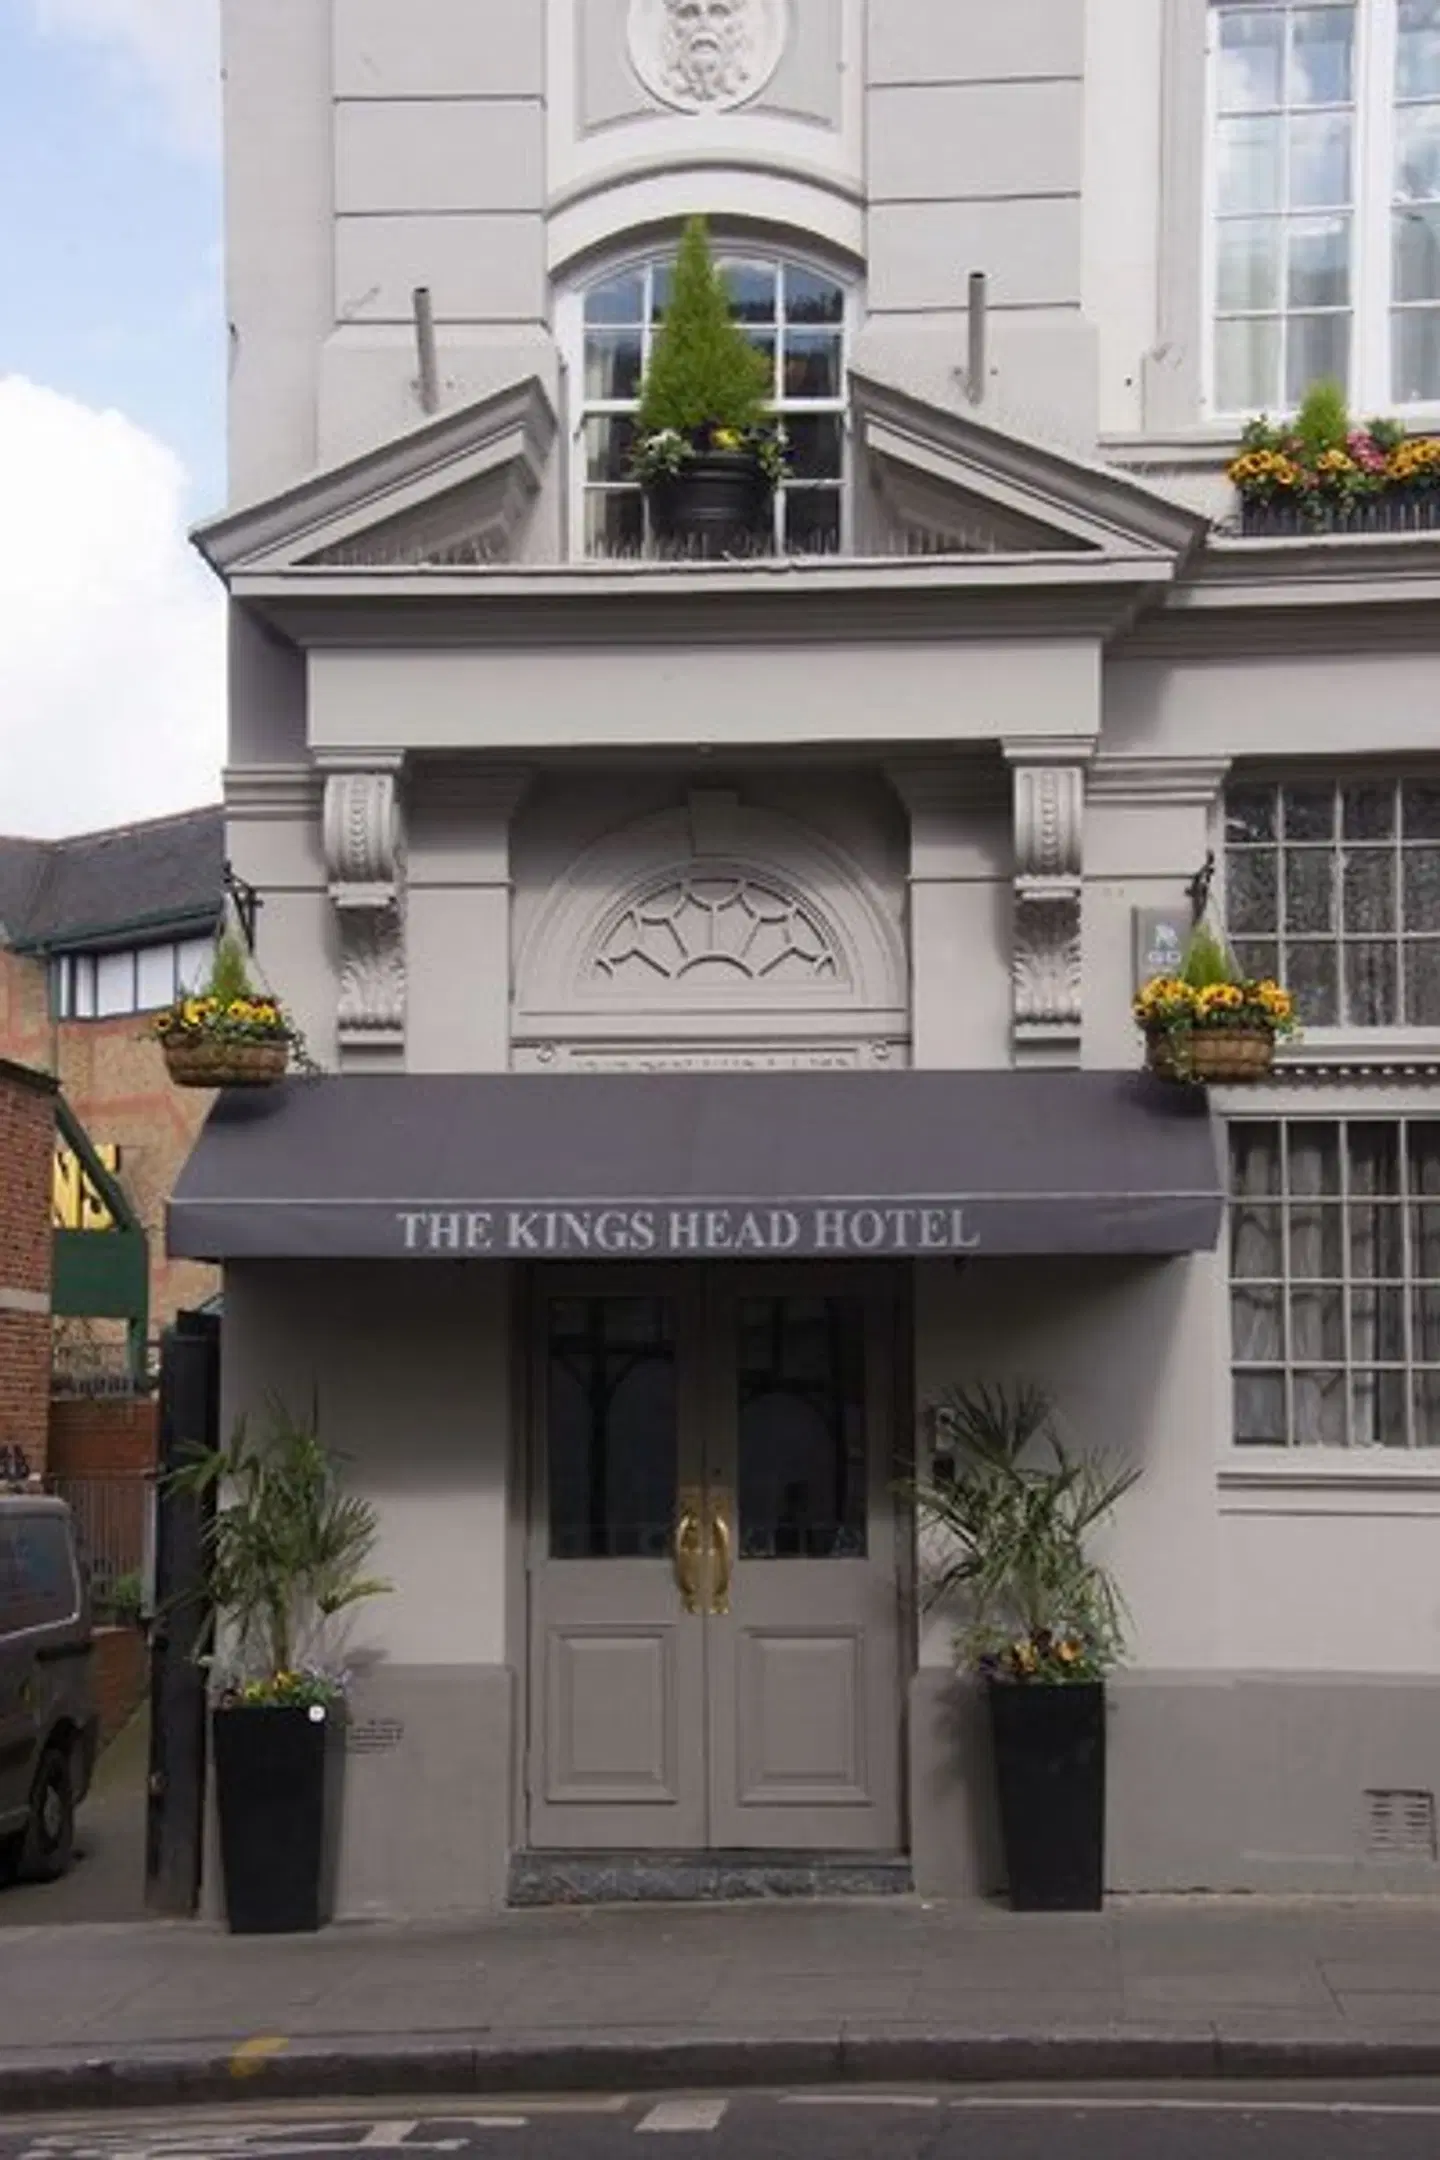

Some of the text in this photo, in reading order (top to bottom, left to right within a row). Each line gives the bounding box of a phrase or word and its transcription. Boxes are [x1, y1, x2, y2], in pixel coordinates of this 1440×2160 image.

[397, 1208, 979, 1251] THE KINGS HEAD HOTEL
